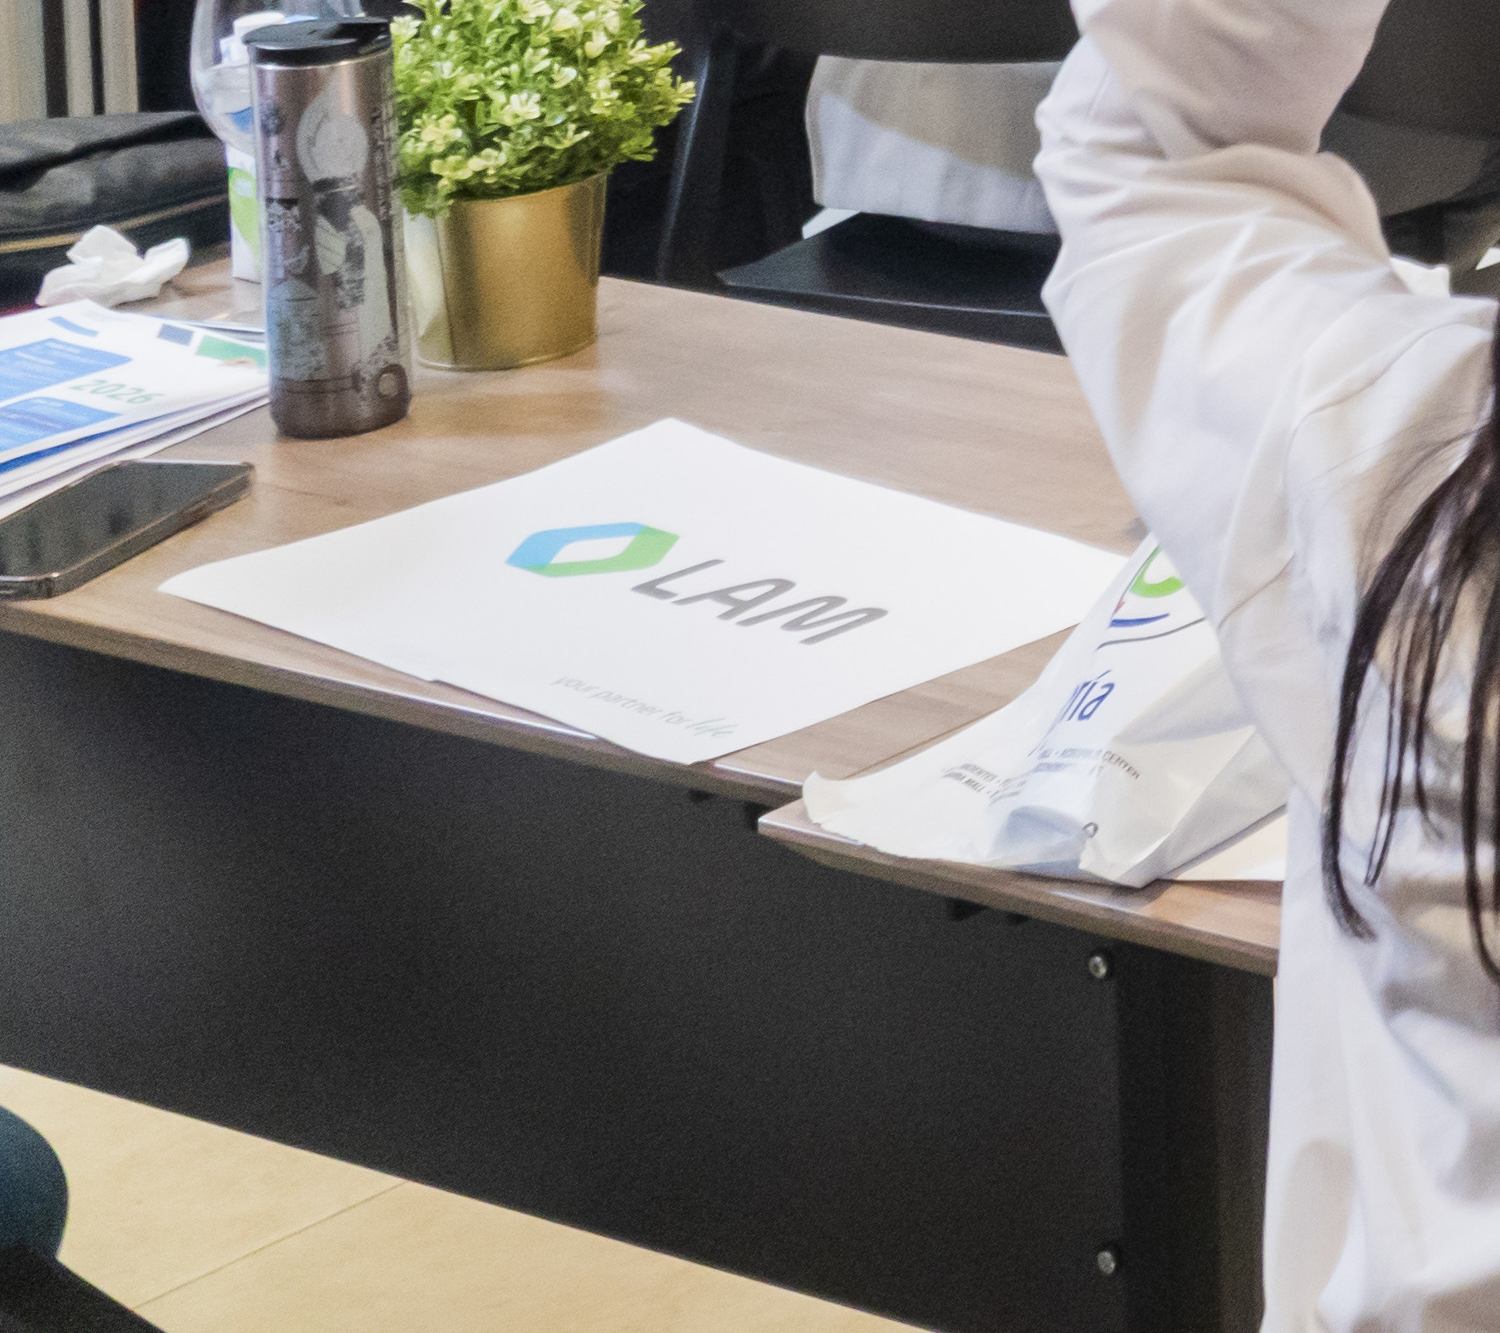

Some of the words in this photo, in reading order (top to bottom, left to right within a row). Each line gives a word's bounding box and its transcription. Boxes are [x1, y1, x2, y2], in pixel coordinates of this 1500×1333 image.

[70, 379, 164, 405] 2026
[630, 558, 889, 646] LAM
[550, 676, 600, 693] your
[588, 689, 663, 716] partner
[660, 710, 693, 725] for
